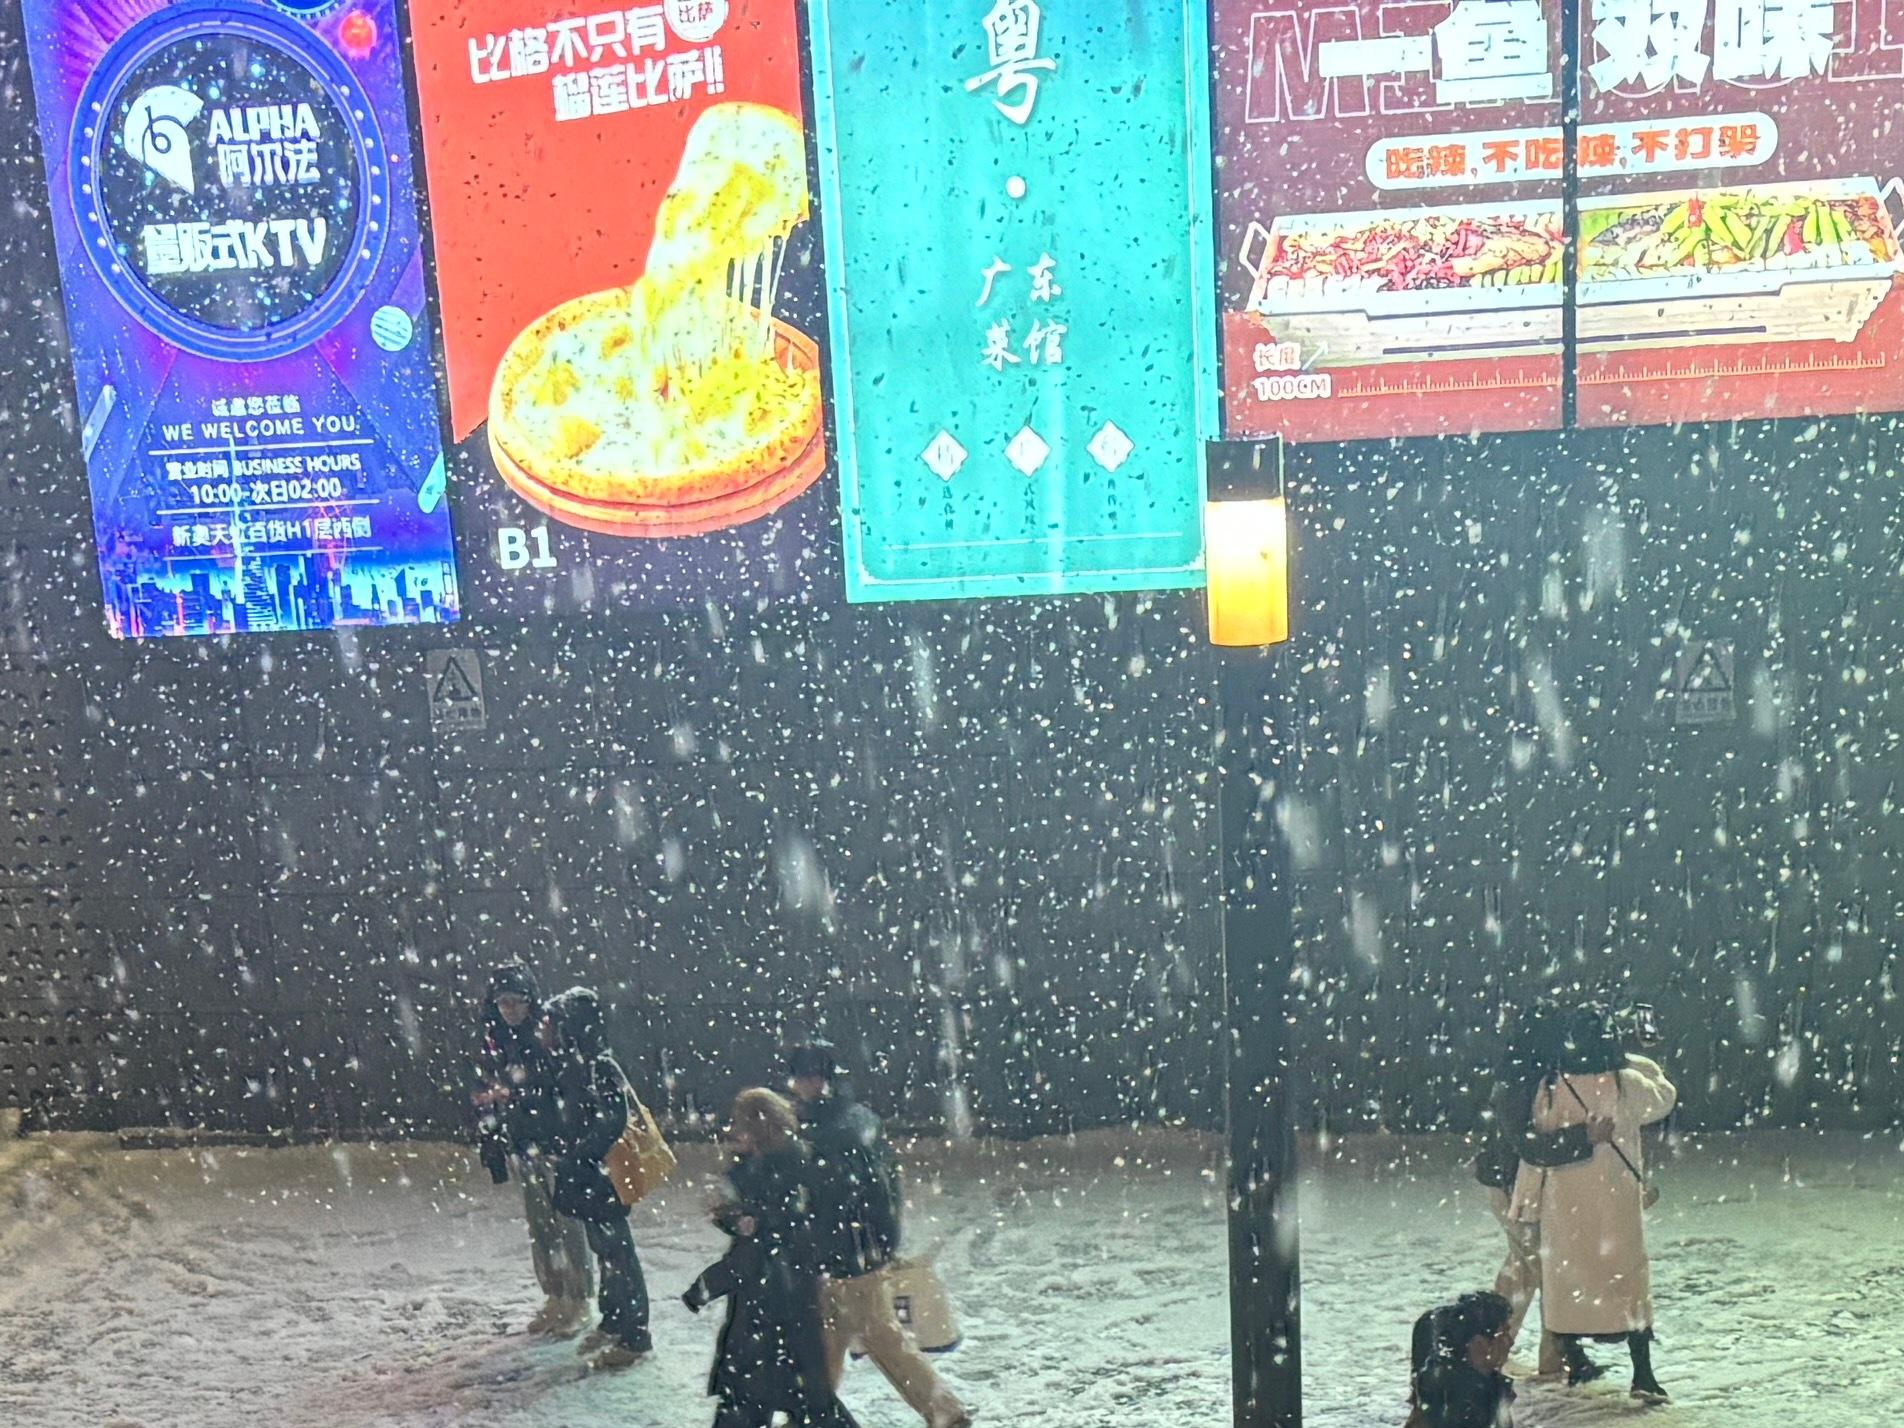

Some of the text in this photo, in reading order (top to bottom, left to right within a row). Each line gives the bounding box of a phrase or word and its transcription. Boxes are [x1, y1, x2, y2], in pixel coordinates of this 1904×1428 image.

[468, 4, 666, 84] 比格不只有
[963, 0, 1057, 125] 粤
[1319, 0, 1834, 104] 一鱼双味
[207, 102, 321, 147] ALPHA
[217, 139, 321, 187] 阿尔法
[142, 217, 327, 275] 量贩式KTV
[976, 251, 1063, 306] 广东
[980, 318, 1068, 372] 菜馆
[1256, 377, 1329, 399] 100CM
[162, 414, 356, 442] WE WELCOME YOU
[166, 453, 361, 481] 营业时间 BUSINESS HOURS
[190, 477, 342, 505] 10:00-次日02:00
[498, 526, 557, 569] B1
